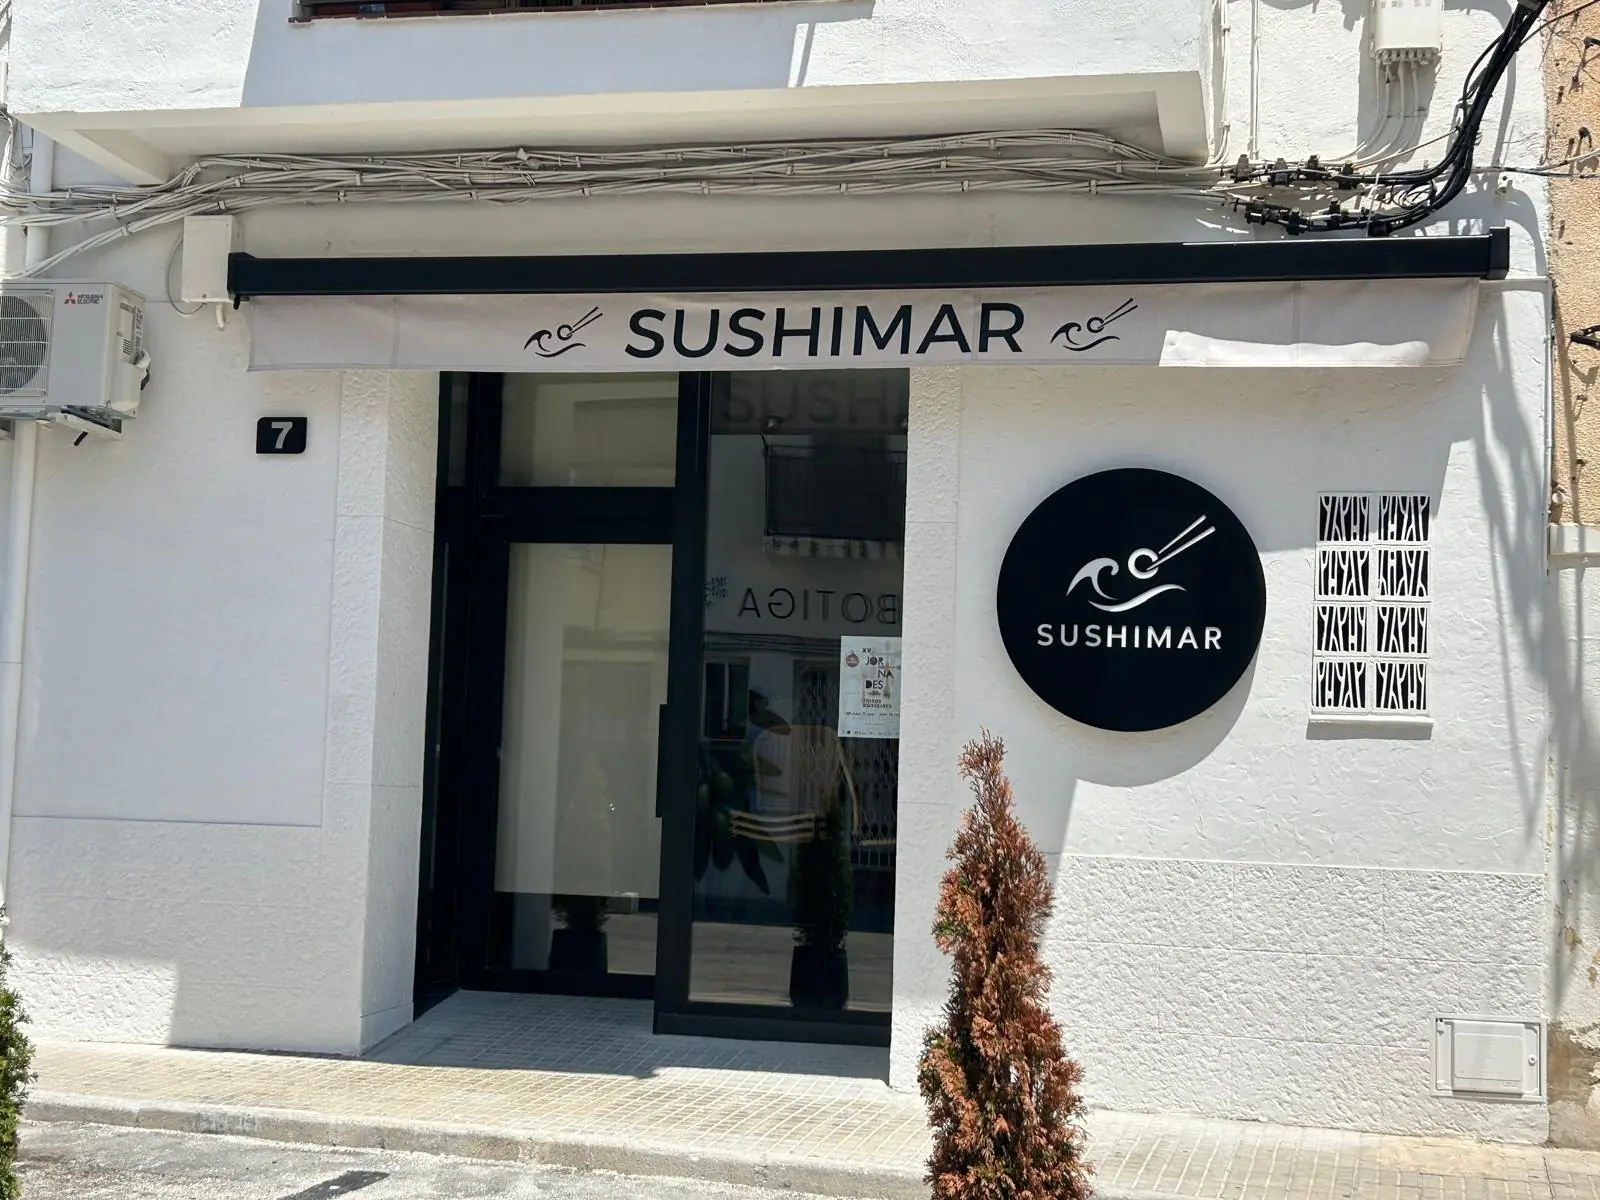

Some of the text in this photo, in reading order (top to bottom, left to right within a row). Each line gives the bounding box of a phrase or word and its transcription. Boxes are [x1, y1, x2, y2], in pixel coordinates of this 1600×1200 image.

[624, 302, 1025, 359] SUSHIMAR
[271, 421, 293, 449] 7
[1036, 623, 1223, 650] SUSHIMAR
[865, 656, 884, 666] JOR
[878, 670, 894, 679] NA
[866, 680, 884, 690] DES
